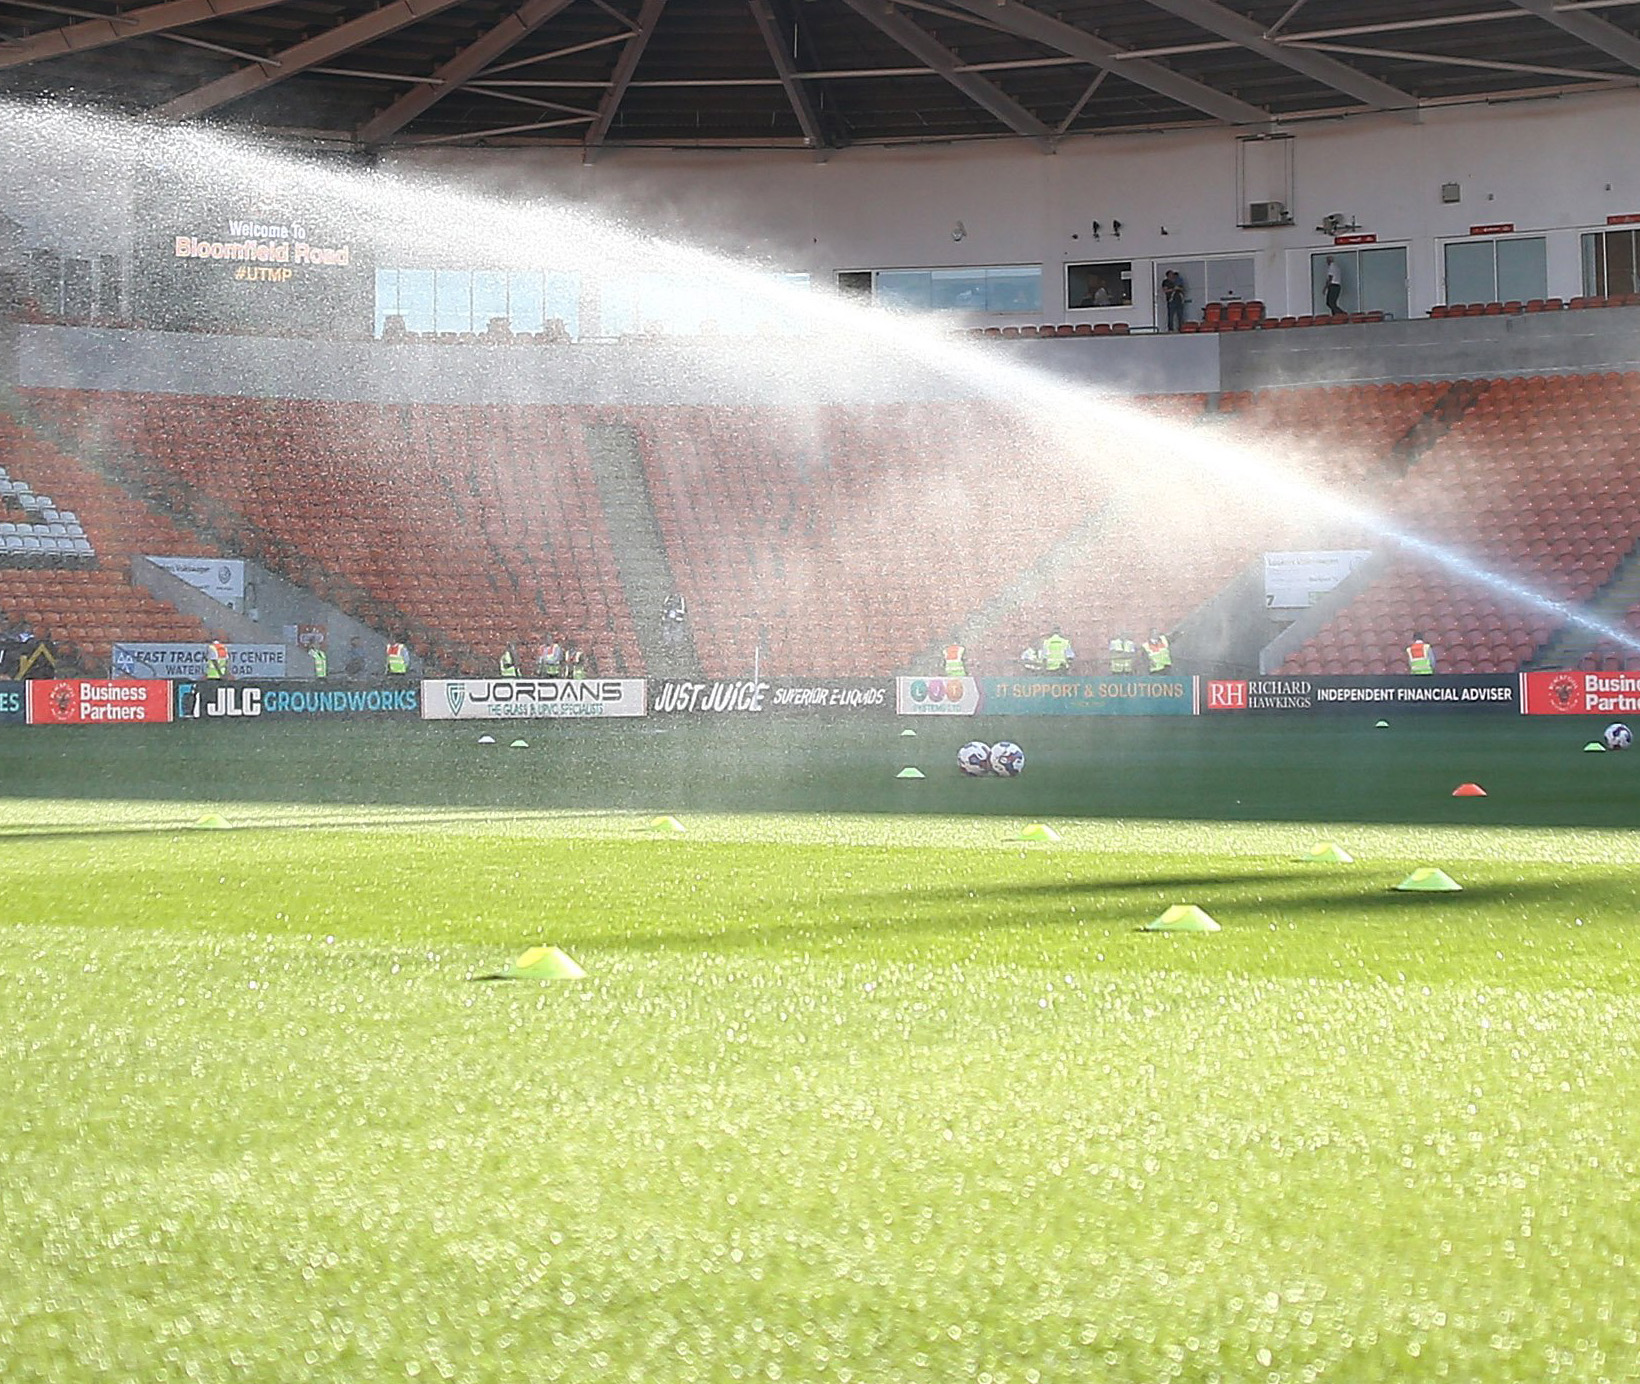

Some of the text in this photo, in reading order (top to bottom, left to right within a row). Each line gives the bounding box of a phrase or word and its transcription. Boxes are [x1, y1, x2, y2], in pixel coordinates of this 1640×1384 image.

[229, 219, 289, 239] Welcome
[175, 235, 349, 266] Bloomfield Road
[234, 266, 293, 283] #UTMP
[136, 650, 166, 664] FAST
[240, 650, 284, 664] CENTRE
[80, 682, 148, 701] Business
[469, 681, 623, 702] JORDANS
[654, 682, 706, 712] JUST
[1012, 683, 1081, 699] SUPPORT
[1084, 684, 1094, 699] &
[1098, 683, 1184, 699] SOLUTIONS
[1210, 683, 1245, 707] RH
[1248, 681, 1311, 695] RICHARD
[1317, 687, 1513, 702] INDEPENDENT FINANCIAL ADVISER
[80, 702, 146, 720] Partners
[207, 687, 418, 717] JLC GROUNDWORKS
[1248, 696, 1311, 709] HAWKINGS
